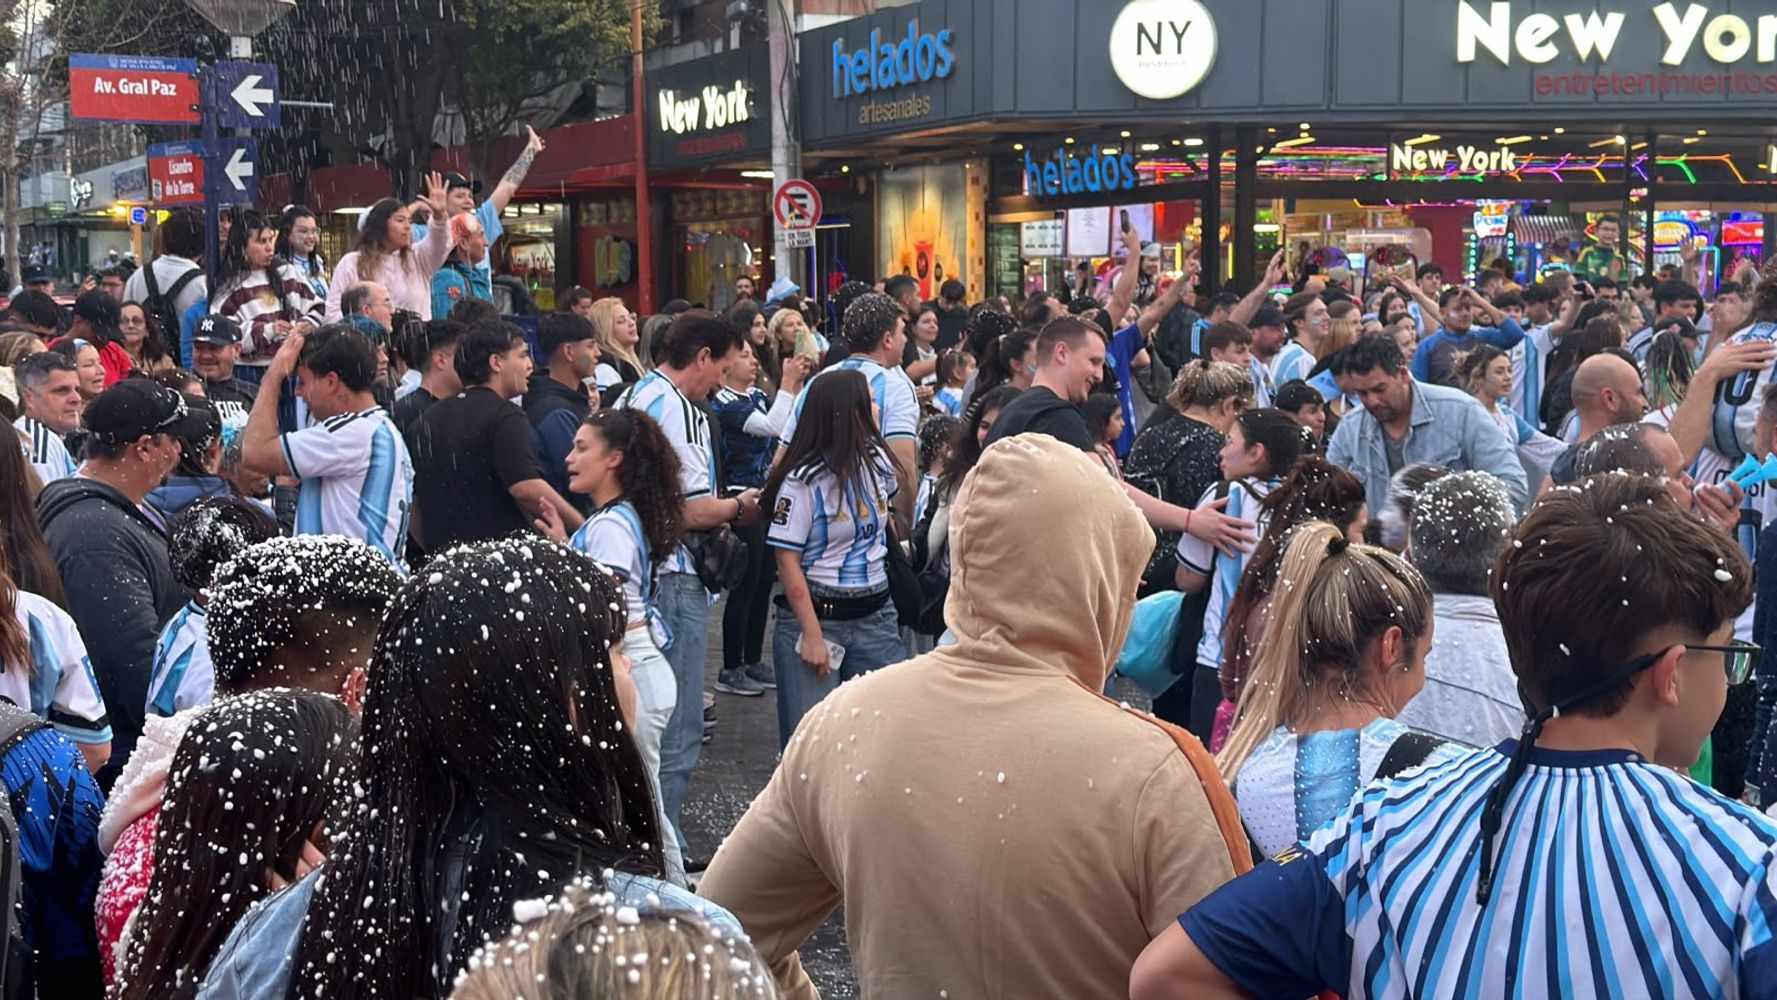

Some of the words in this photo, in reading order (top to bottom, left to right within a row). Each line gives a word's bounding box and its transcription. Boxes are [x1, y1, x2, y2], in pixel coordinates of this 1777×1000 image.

[1136, 20, 1192, 56] NY
[1457, 0, 1625, 66] New
[832, 18, 954, 98] helados
[94, 77, 116, 94] Av.
[119, 78, 148, 95] Gral
[151, 79, 177, 96] Paz
[1535, 69, 1777, 96] entretenimientos
[659, 88, 700, 134] New
[702, 79, 749, 130] York
[858, 92, 931, 124] artesanales
[168, 159, 193, 175] Lisandro
[1023, 143, 1135, 197] helados
[1393, 145, 1448, 171] New
[1457, 145, 1517, 172] York
[165, 181, 173, 196] de
[173, 180, 179, 195] la
[179, 180, 194, 194] Torre
